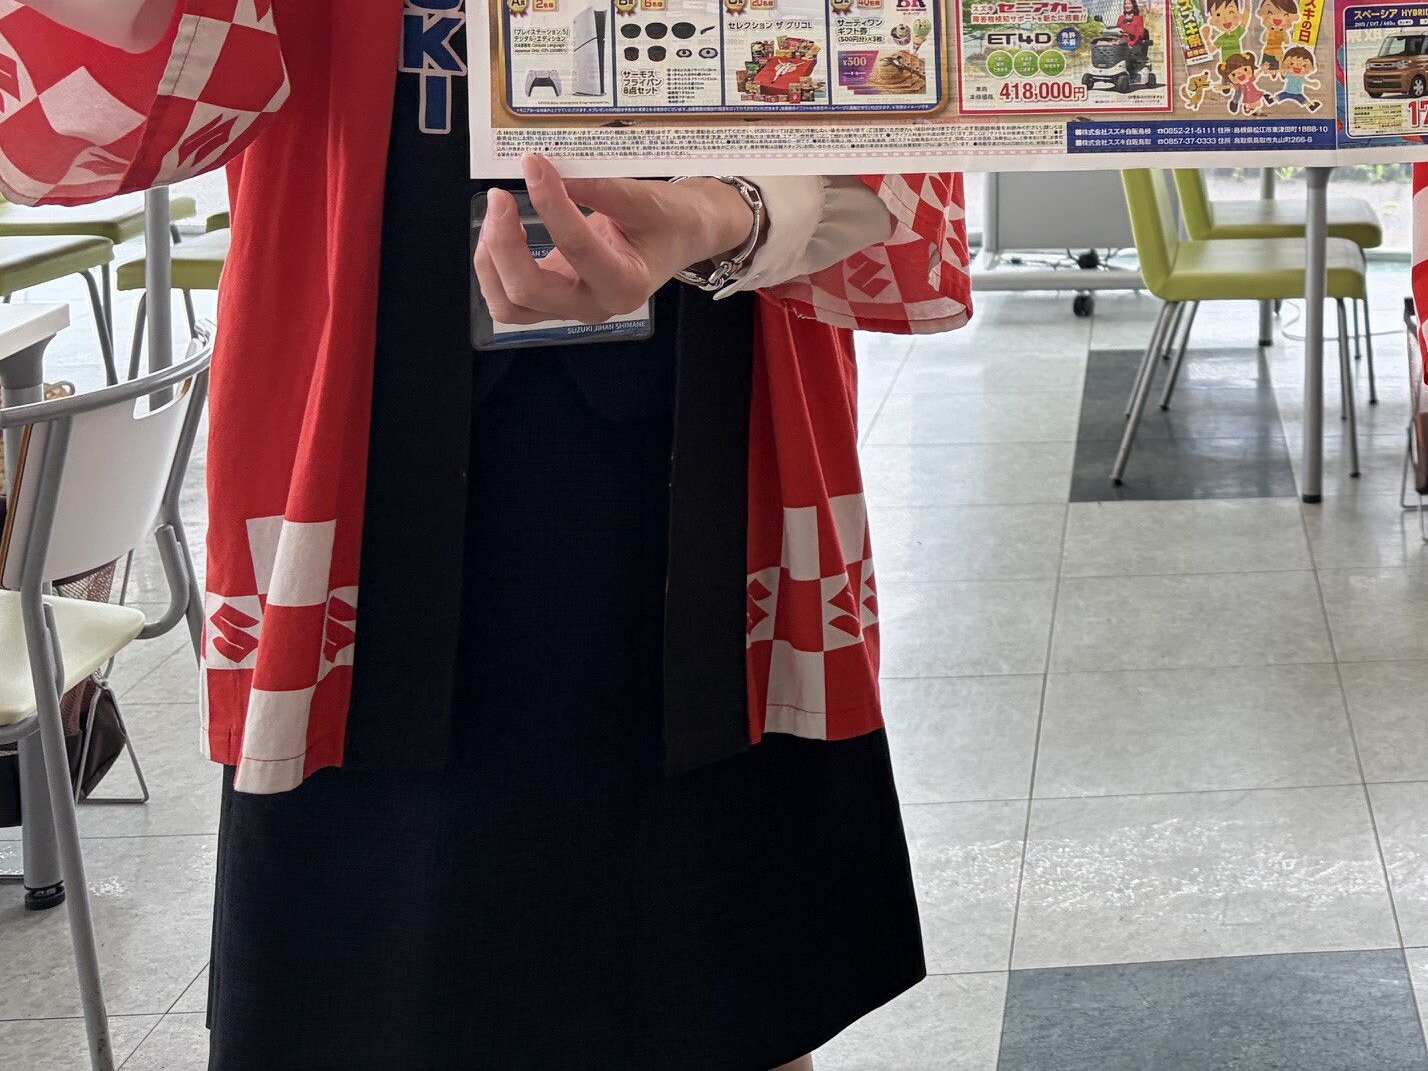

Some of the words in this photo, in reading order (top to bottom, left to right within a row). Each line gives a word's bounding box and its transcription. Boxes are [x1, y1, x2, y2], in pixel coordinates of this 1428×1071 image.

[998, 2, 1083, 13] セニアカー
[1354, 8, 1398, 18] スペーシア
[728, 21, 773, 29] セレクション
[837, 18, 883, 27] サーティワン
[837, 27, 868, 35] ギフト券
[987, 33, 1051, 45] ET4D
[622, 70, 656, 78] サーモス
[622, 79, 662, 87] フライパン
[623, 87, 659, 95] 8点セット
[1000, 82, 1087, 101] 418,000円
[567, 326, 593, 335] SUZUKI
[594, 324, 614, 333] JIHAN
[615, 321, 646, 330] SHIMANE
